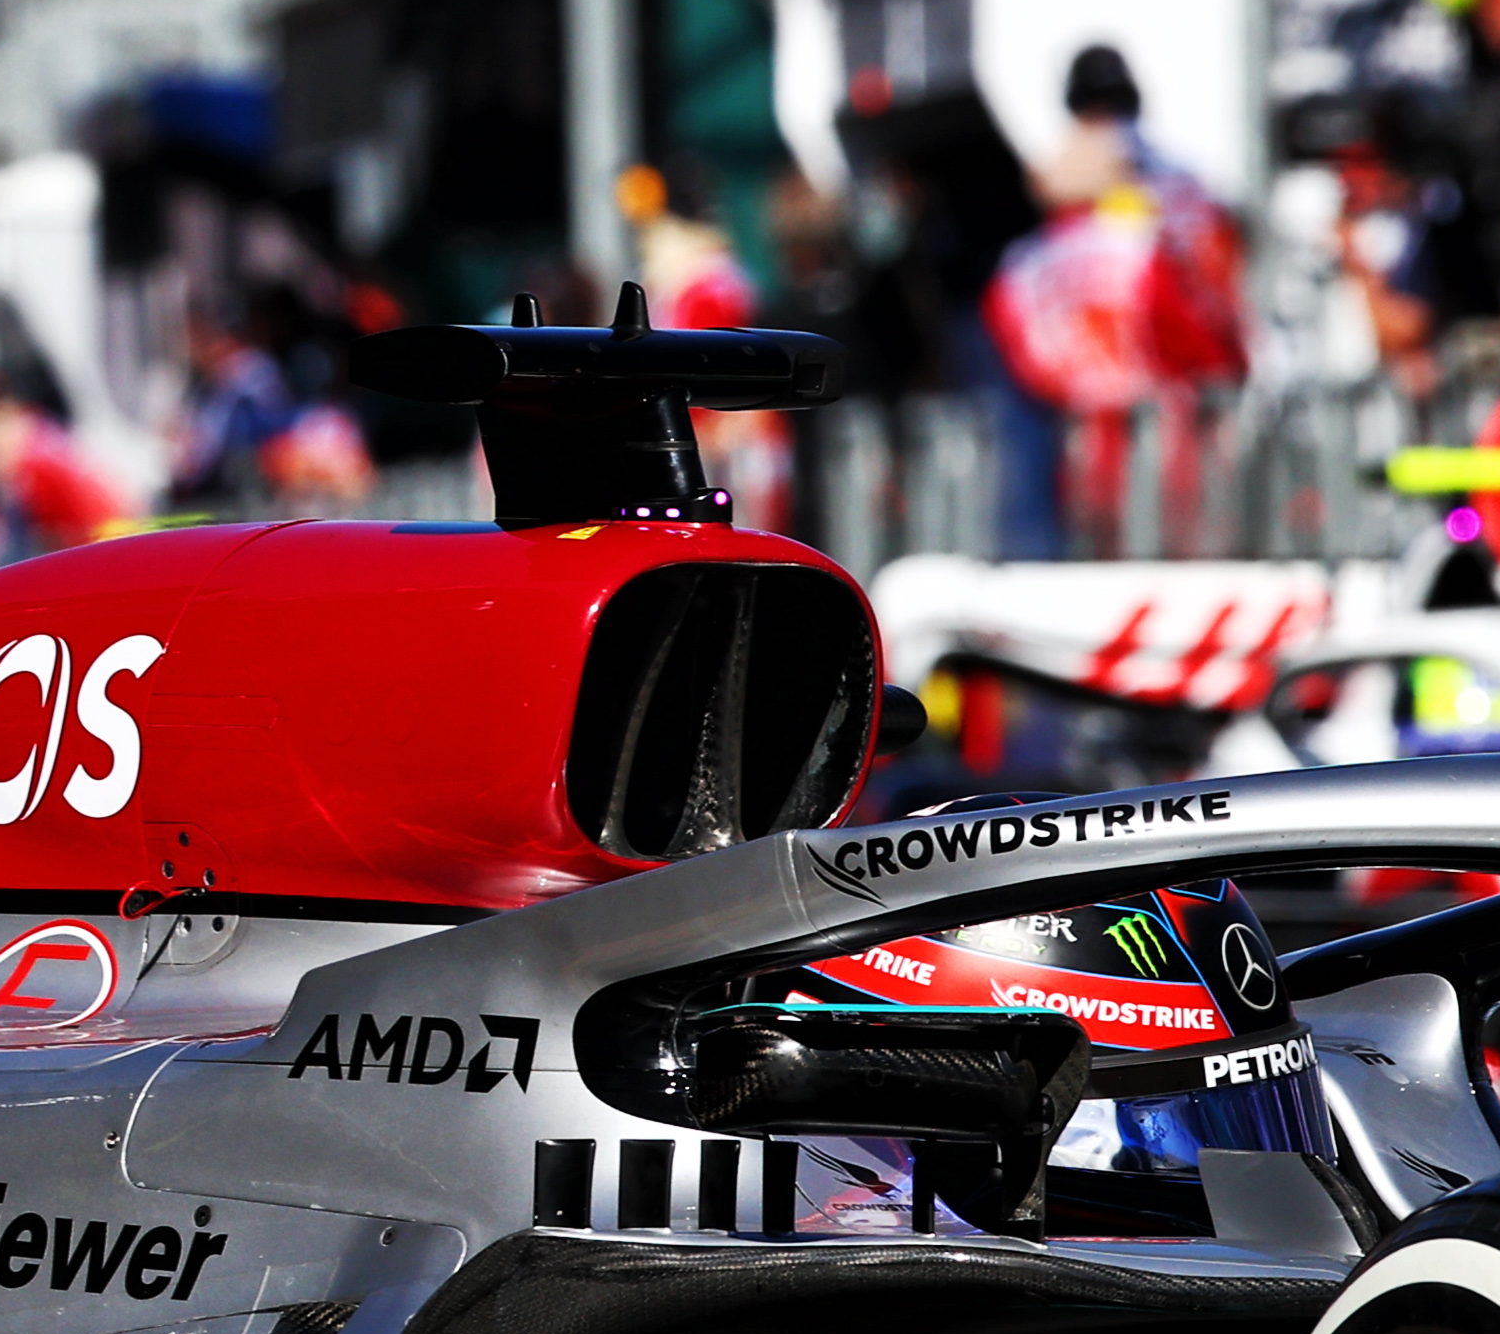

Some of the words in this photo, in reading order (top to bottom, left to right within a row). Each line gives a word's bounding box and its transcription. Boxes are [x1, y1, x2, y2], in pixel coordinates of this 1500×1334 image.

[832, 789, 1233, 881] CROWDSTRIKE
[1004, 984, 1218, 1031] CROWDSTRIKE
[288, 1011, 466, 1088] AMD
[1202, 1033, 1318, 1089] PETRON
